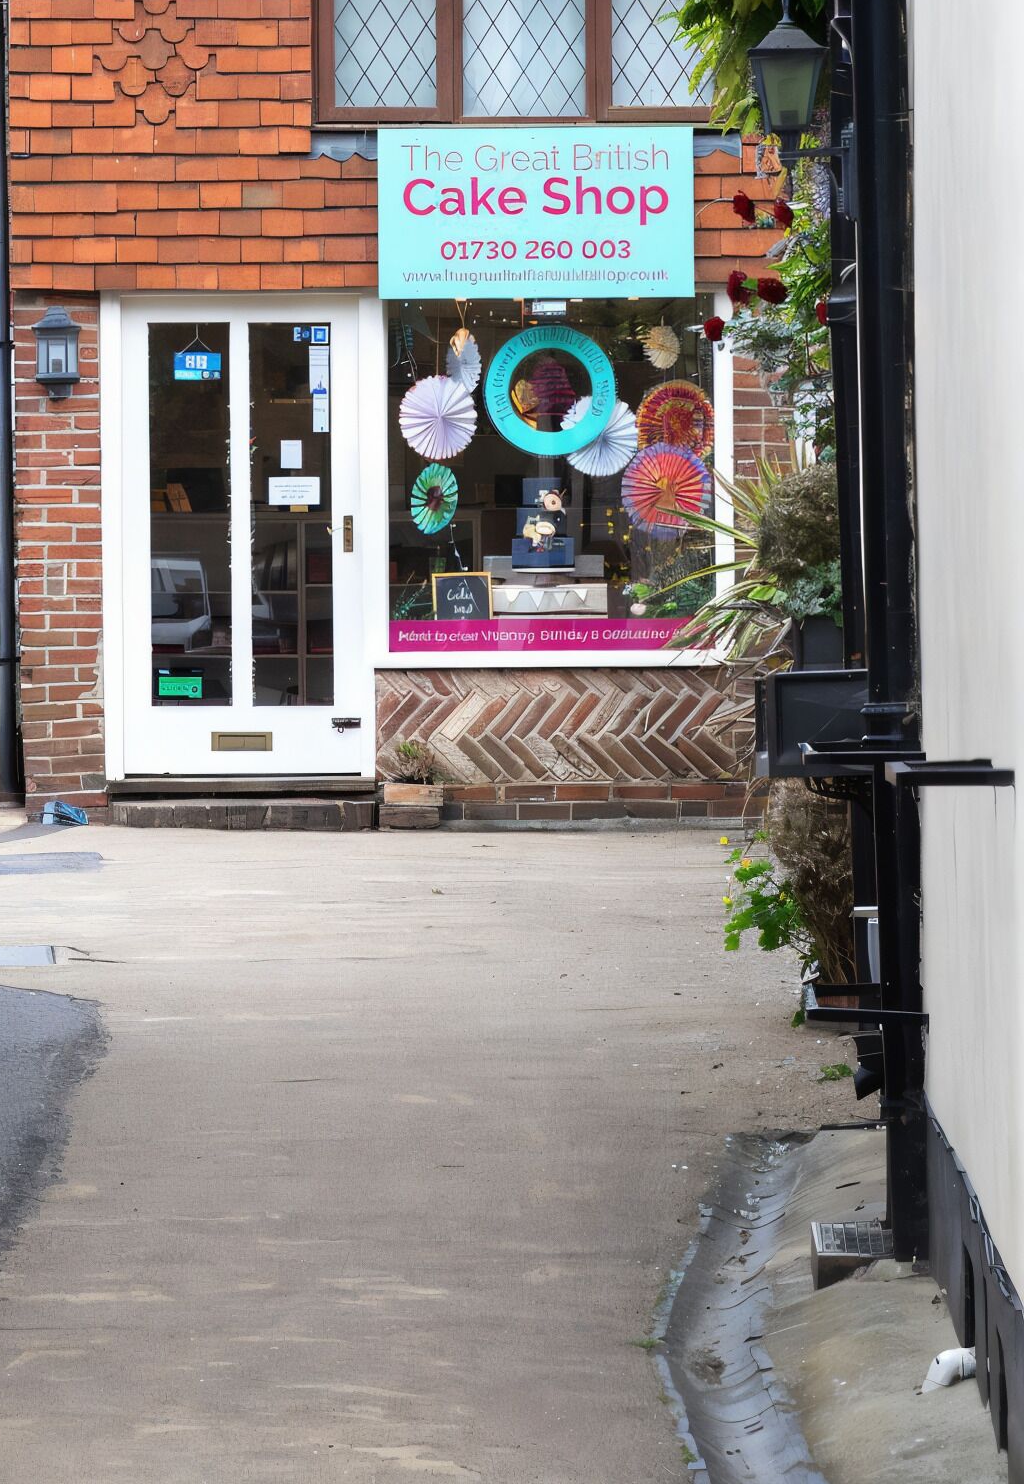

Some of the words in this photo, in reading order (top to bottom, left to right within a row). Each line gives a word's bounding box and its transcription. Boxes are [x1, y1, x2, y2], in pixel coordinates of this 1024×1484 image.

[401, 144, 463, 171] The
[474, 144, 561, 172] Great
[573, 142, 669, 171] British
[403, 176, 527, 216] Cake
[542, 176, 669, 225] Shop
[440, 240, 517, 260] 01730
[525, 240, 573, 260] 260
[582, 239, 631, 259] 003
